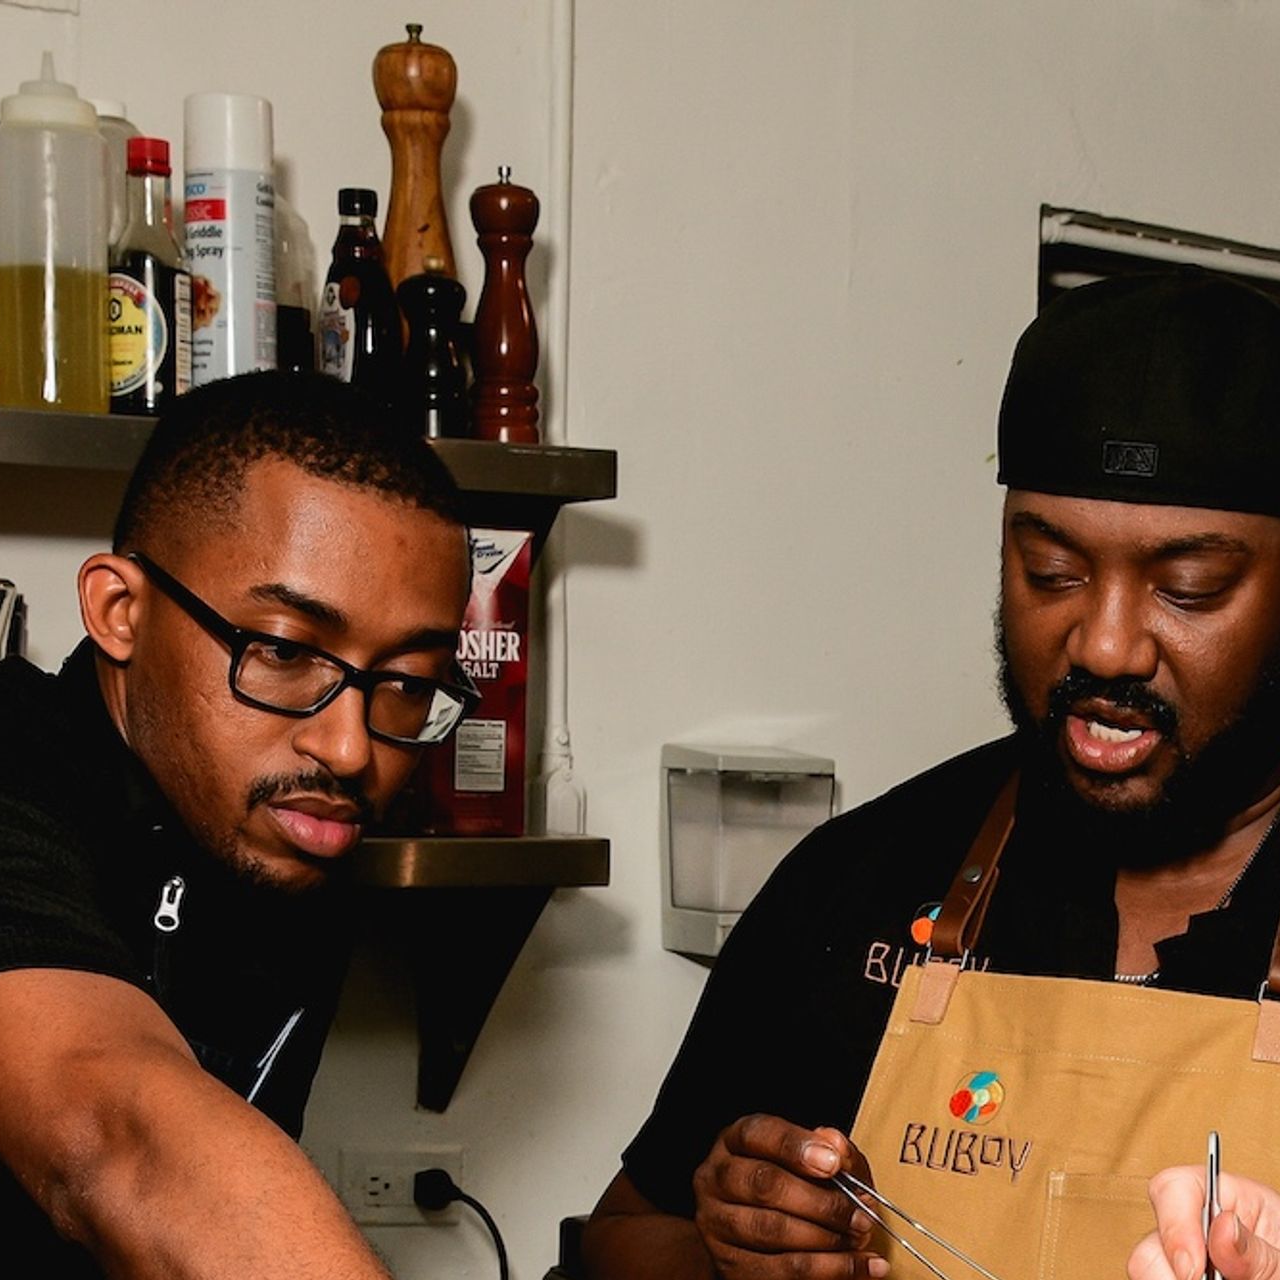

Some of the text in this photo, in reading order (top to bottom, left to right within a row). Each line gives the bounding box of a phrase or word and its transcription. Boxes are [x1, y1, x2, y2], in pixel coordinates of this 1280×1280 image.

[108, 325, 143, 335] OMAN
[456, 629, 520, 661] OSHER
[463, 661, 499, 678] SALT
[898, 1122, 1033, 1185] BUBOY
